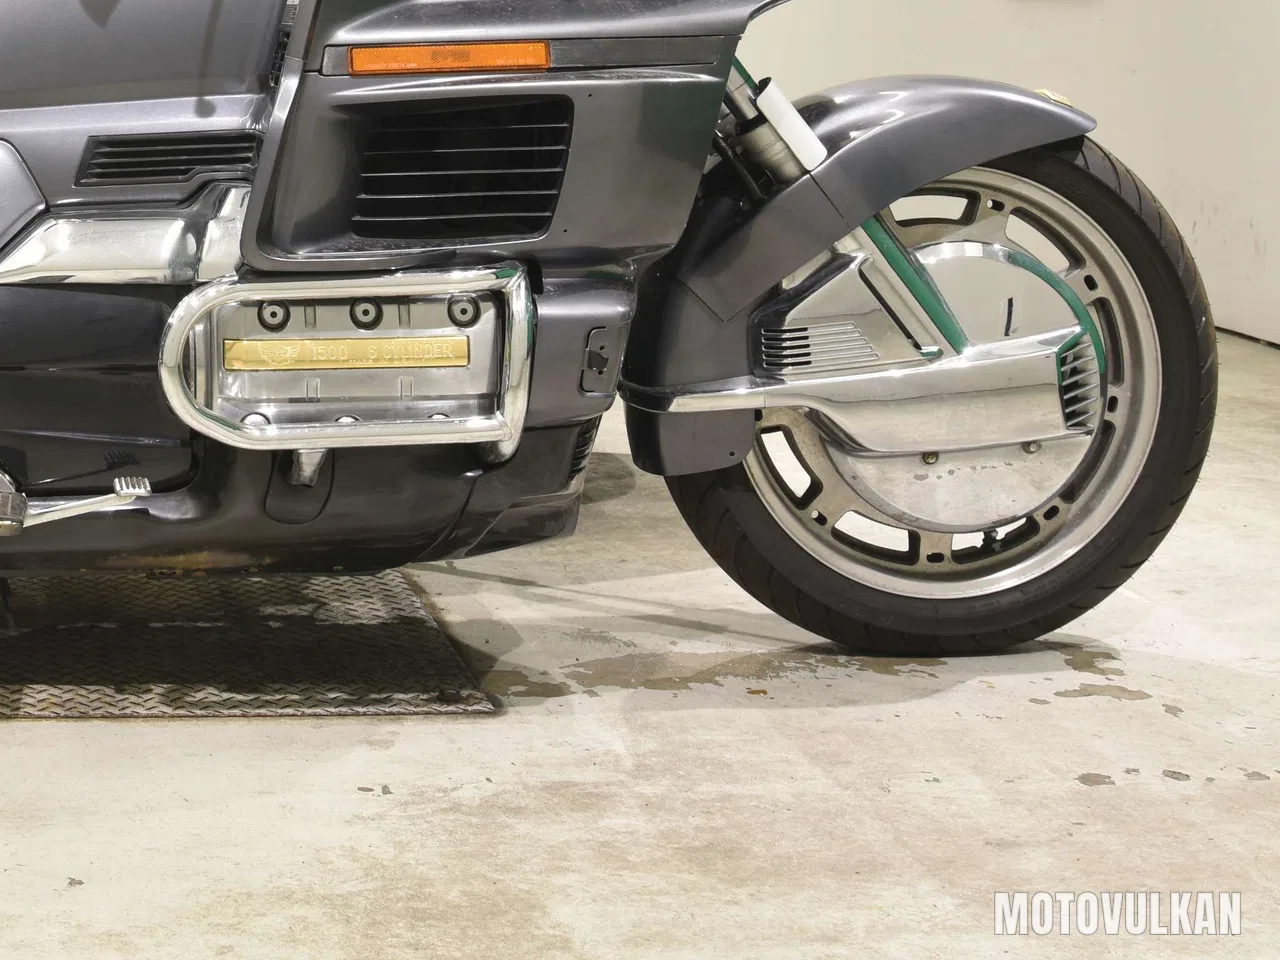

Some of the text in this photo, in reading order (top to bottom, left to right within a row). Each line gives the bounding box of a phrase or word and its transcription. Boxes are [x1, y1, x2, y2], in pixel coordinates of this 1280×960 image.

[311, 342, 455, 360] 1500 6 CYLINDER
